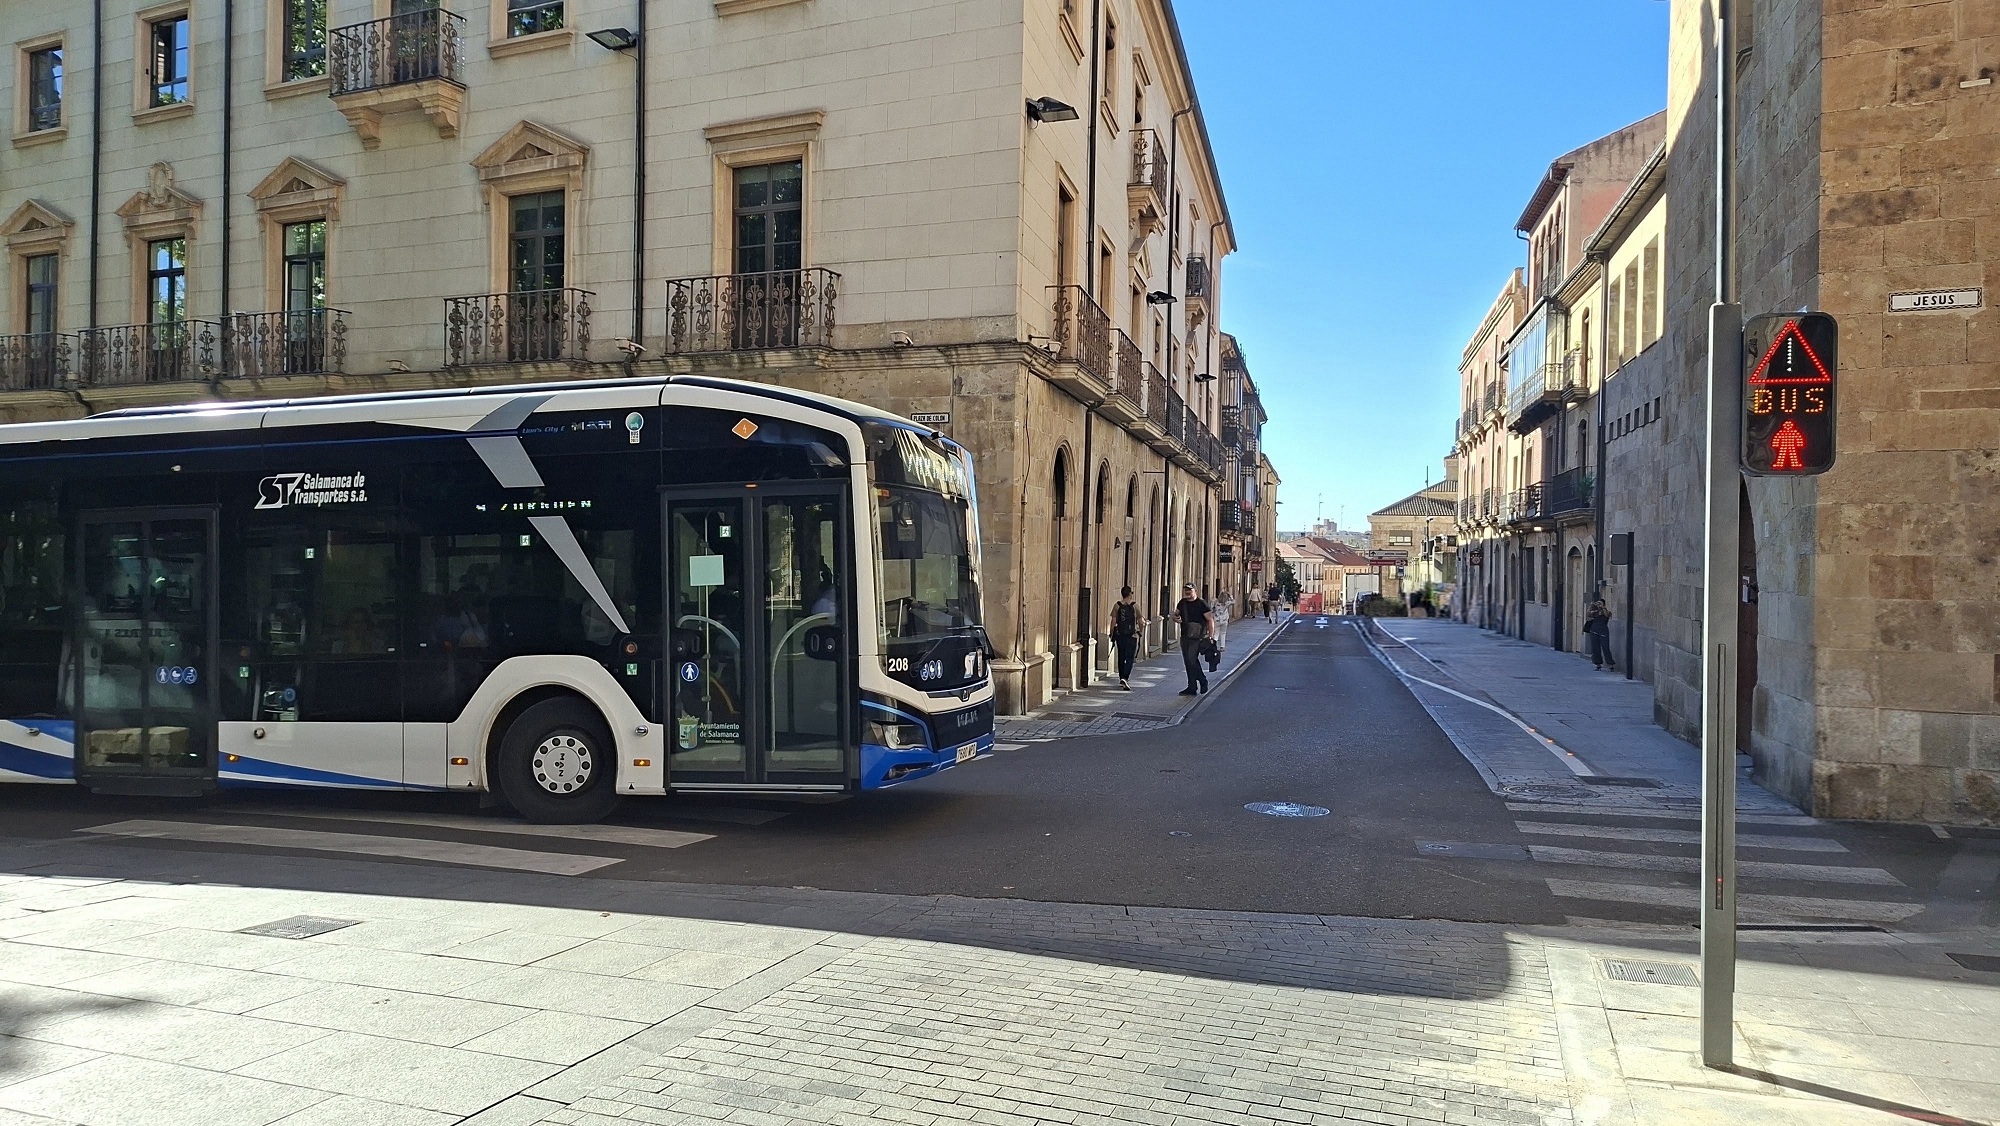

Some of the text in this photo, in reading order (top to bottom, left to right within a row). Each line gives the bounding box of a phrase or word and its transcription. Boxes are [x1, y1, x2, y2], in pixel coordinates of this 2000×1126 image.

[1913, 294, 1955, 306] JESUS
[1754, 387, 1825, 414] BUS
[303, 471, 365, 489] Salamanca de
[294, 488, 368, 507] Transportes s.a.
[888, 657, 909, 672] 208
[699, 722, 740, 730] Ayuntamiento
[699, 730, 740, 738] de Salamanca
